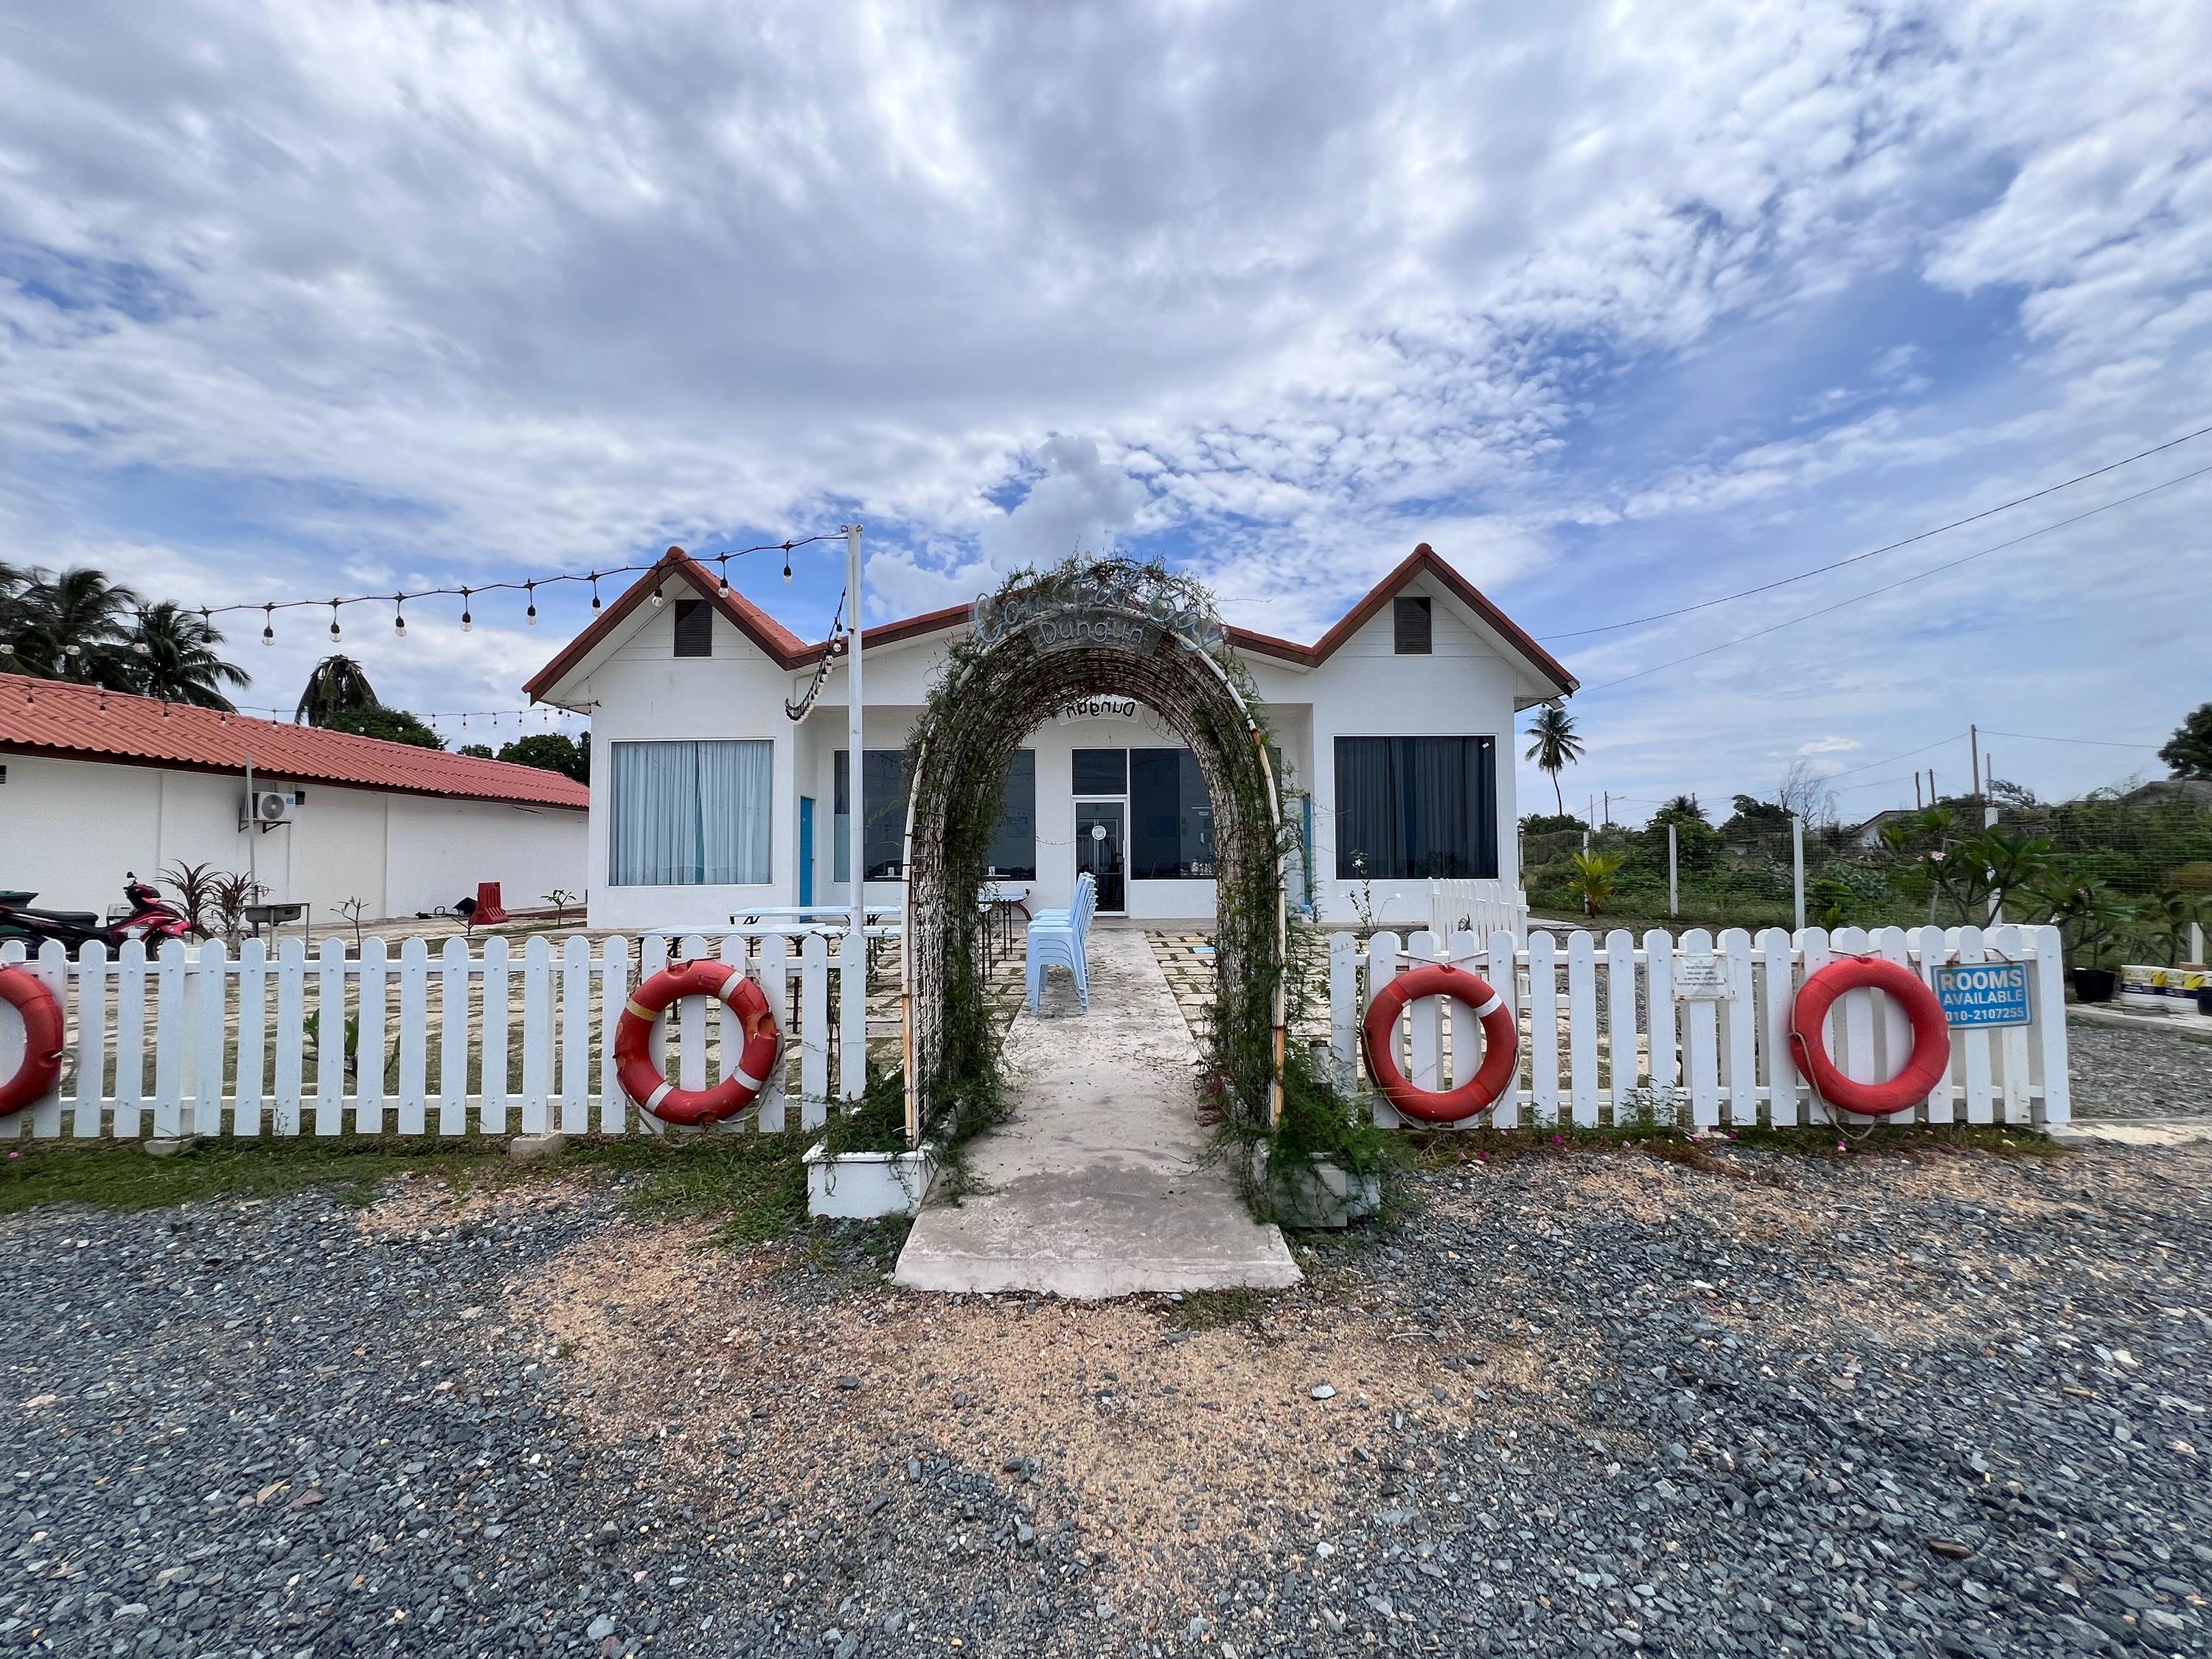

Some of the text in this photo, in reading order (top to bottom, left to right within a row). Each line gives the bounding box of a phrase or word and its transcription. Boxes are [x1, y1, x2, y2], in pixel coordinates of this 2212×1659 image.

[1040, 620, 1143, 645] Dungun
[1940, 969, 2023, 992] ROOMS
[1943, 990, 2023, 1006] AVAILABLE
[1945, 1007, 2024, 1022] 010-2107255
